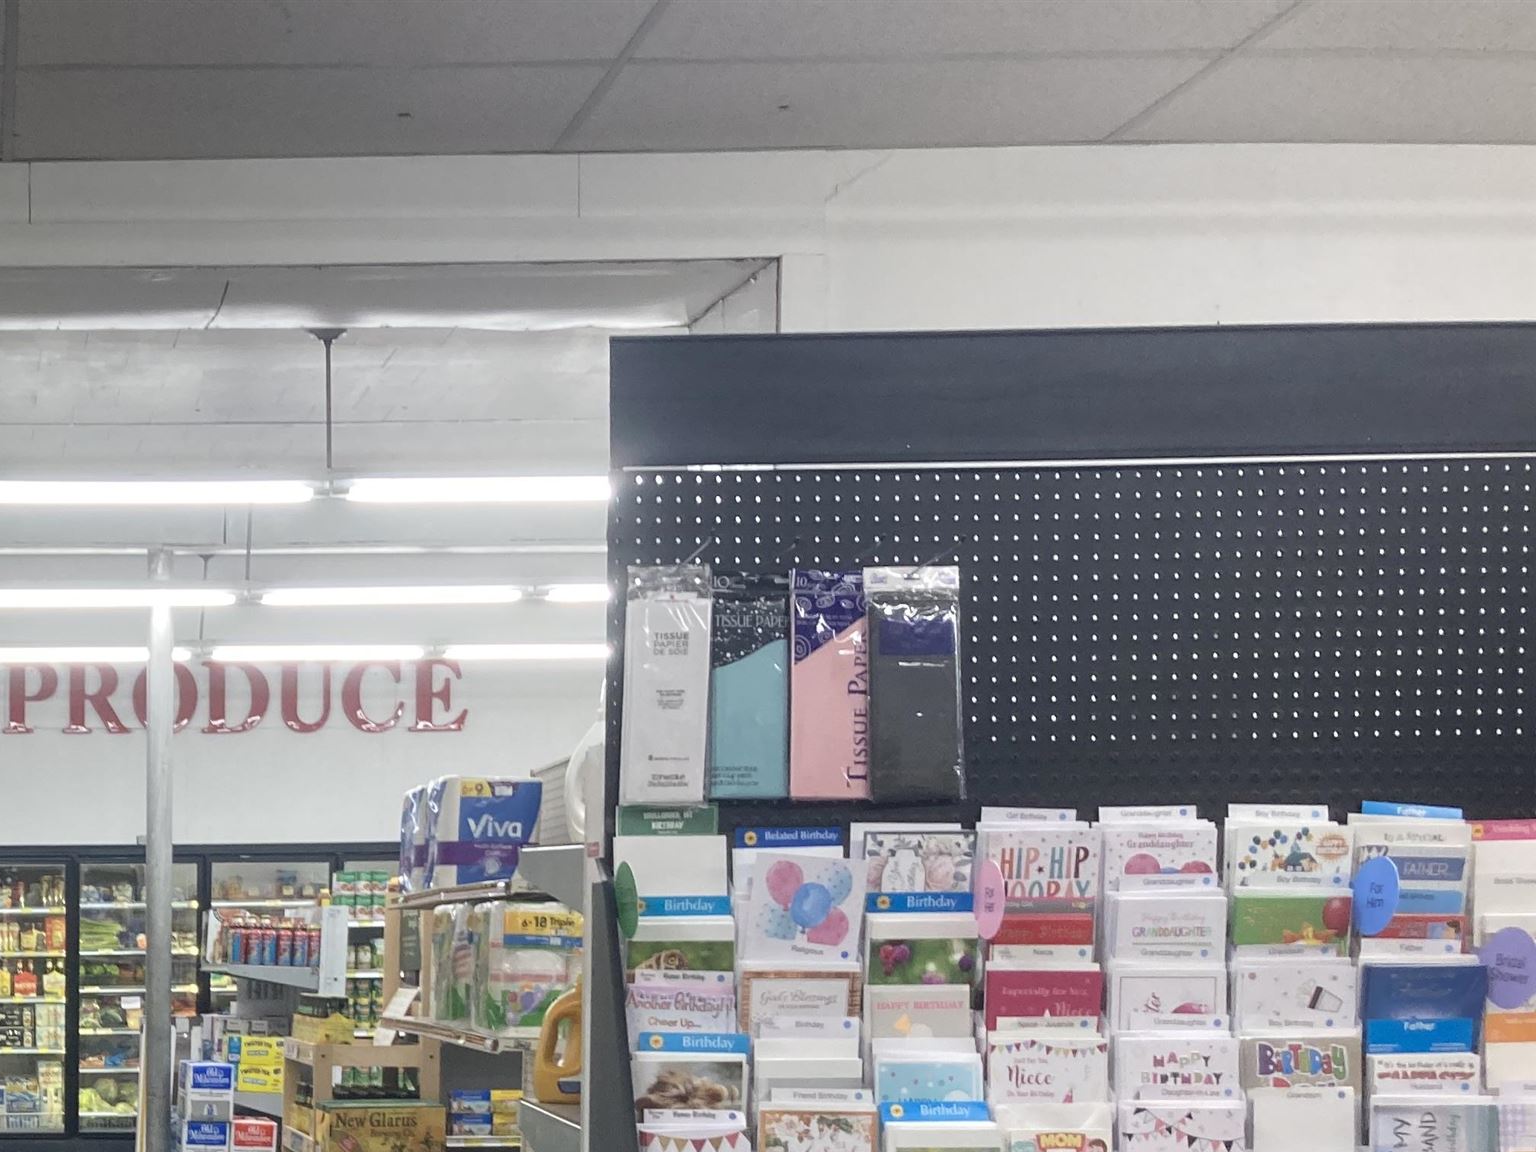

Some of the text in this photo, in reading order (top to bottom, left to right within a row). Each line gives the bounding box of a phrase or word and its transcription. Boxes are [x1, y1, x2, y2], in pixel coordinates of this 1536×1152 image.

[715, 613, 753, 628] TISSUE
[655, 632, 689, 640] TISSUE
[1, 660, 468, 734] PRODUCE
[468, 814, 523, 838] Viva
[764, 830, 839, 842] Belated Birthday
[1000, 846, 1090, 879] HIP HIP
[664, 899, 714, 913] Birthday
[906, 896, 957, 911] Birthday
[877, 1001, 910, 1010] HAPPY
[648, 1016, 679, 1028] Cheer
[795, 1020, 825, 1030] Birthday
[682, 1035, 736, 1050] Birthday
[818, 1091, 848, 1101] Birthday
[919, 1104, 971, 1119] Birthday
[334, 1112, 417, 1129] New Glarus
[1041, 1133, 1083, 1148] MOM
